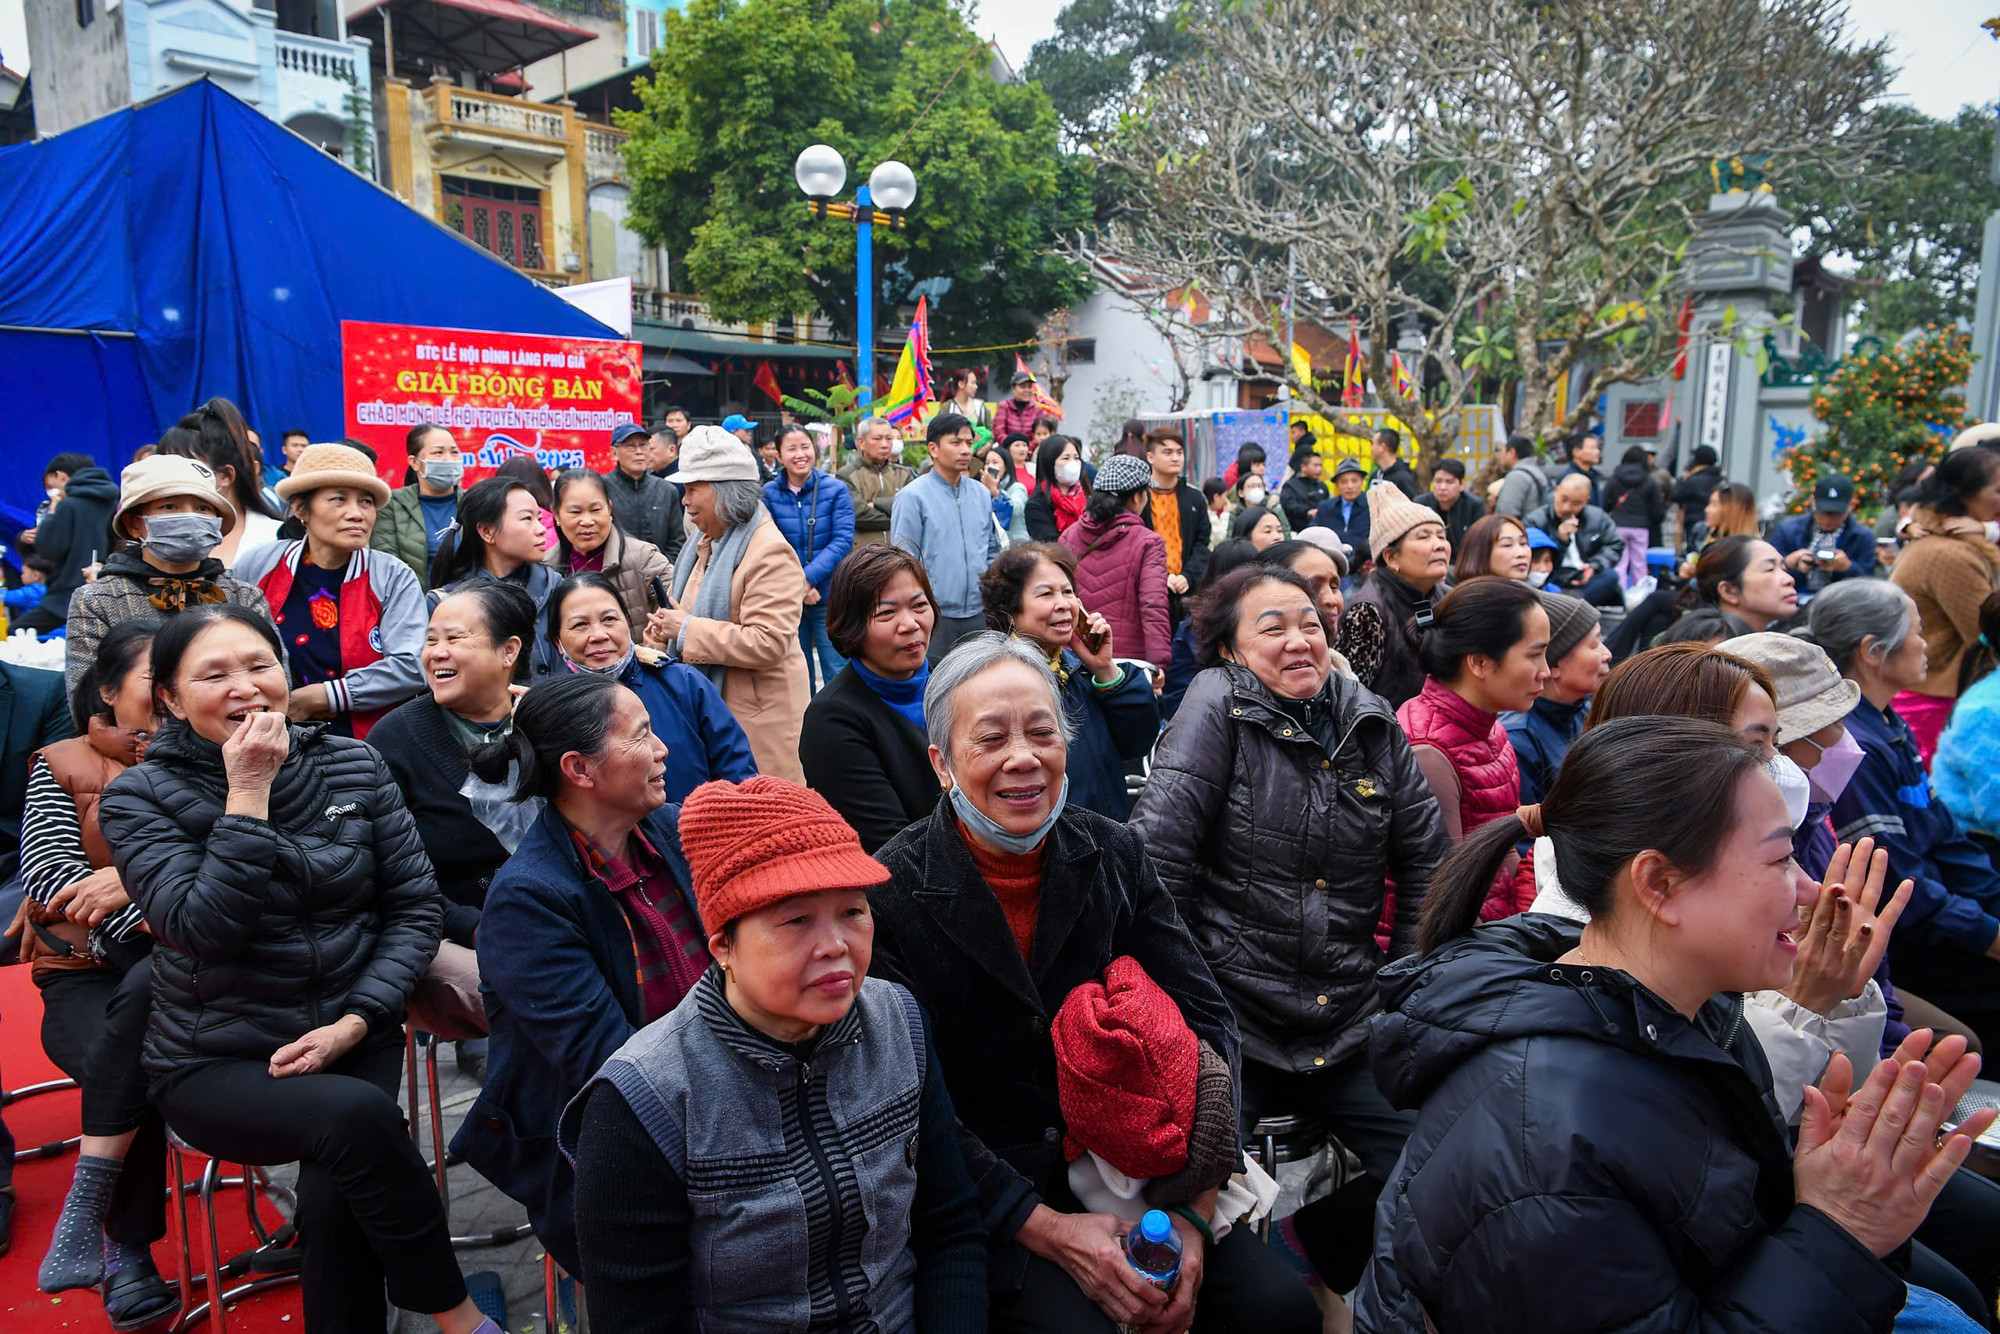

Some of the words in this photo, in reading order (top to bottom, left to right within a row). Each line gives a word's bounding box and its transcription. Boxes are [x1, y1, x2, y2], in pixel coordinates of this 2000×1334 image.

[416, 344, 440, 360] BTC
[460, 345, 479, 366] HỘI
[481, 346, 510, 365] ĐÌNH
[512, 348, 541, 367] LÀNG
[397, 363, 459, 395] GIẢI
[468, 370, 545, 398] BÓNG
[552, 375, 604, 400] BÀN
[534, 449, 586, 469] 2025
